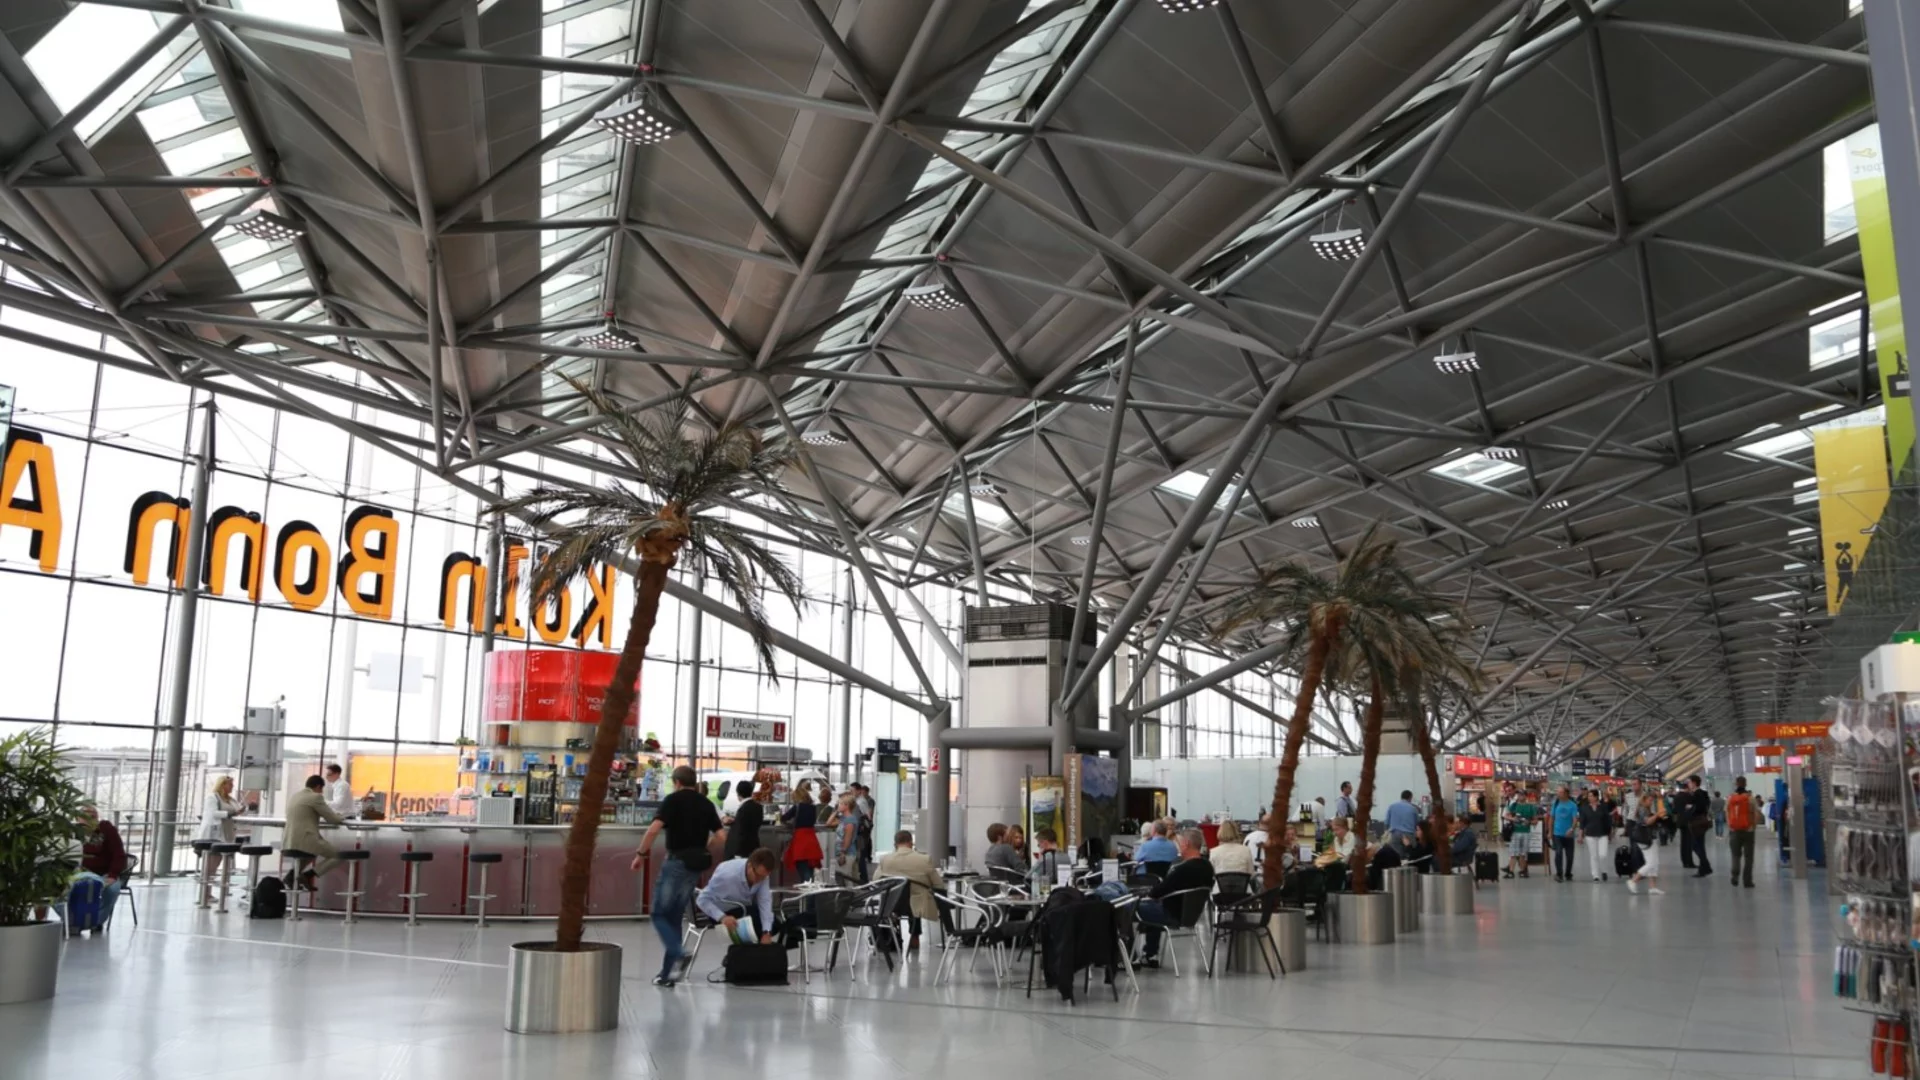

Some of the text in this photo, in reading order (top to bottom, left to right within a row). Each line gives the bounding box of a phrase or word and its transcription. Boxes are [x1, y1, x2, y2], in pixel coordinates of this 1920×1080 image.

[732, 718, 762, 730] Please
[723, 729, 749, 740] order
[751, 730, 771, 741] here
